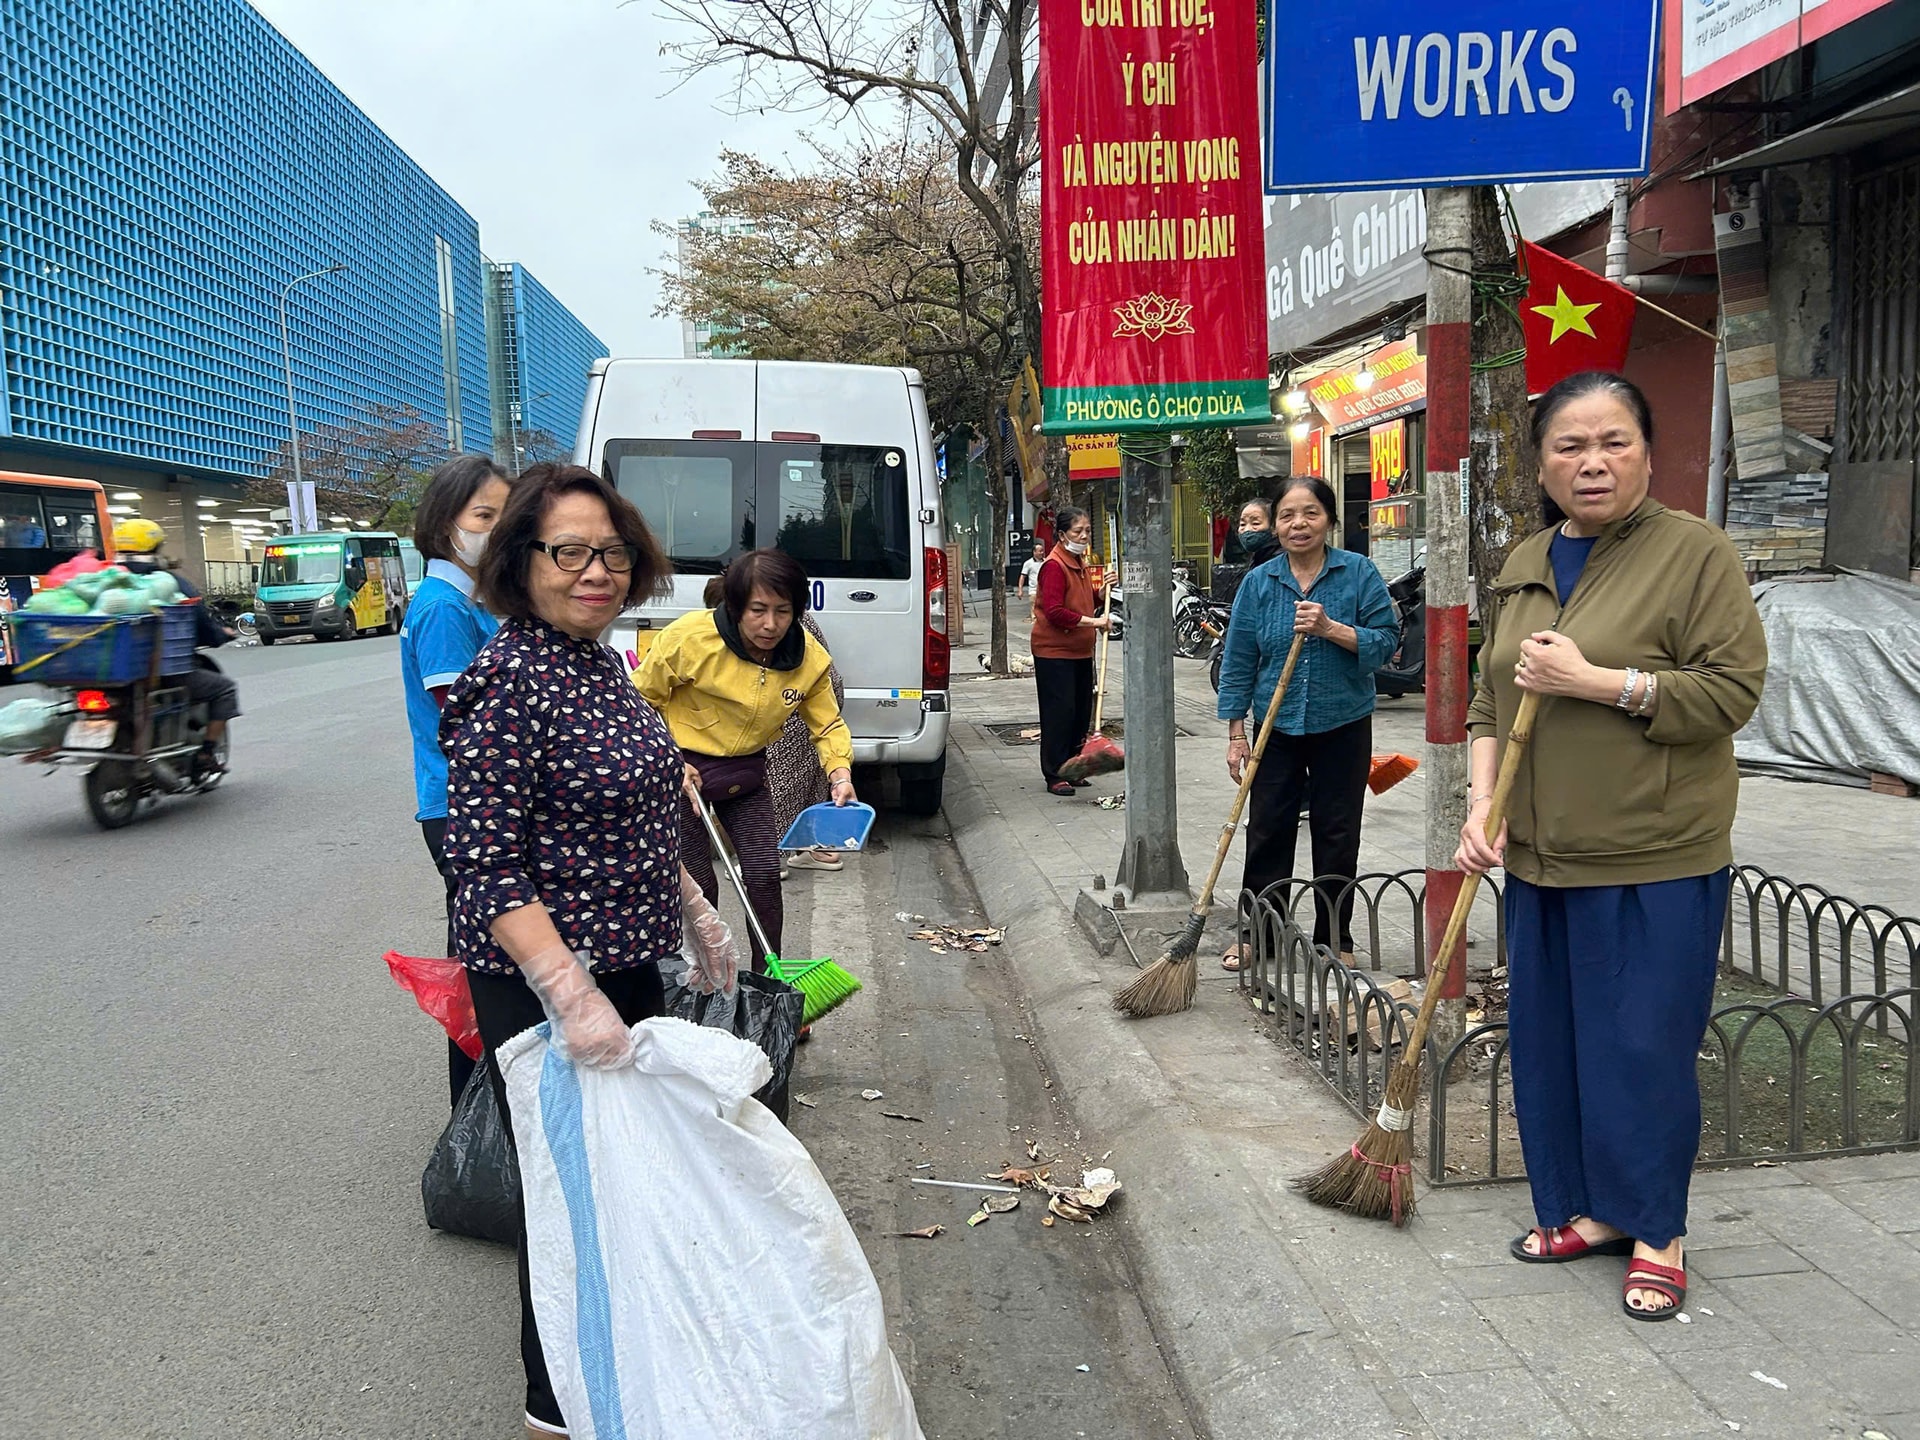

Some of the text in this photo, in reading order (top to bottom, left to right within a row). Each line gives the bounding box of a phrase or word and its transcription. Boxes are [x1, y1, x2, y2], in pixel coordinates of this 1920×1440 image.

[1122, 53, 1176, 106] Ý CHÍ
[1354, 27, 1577, 120] WORKS
[1063, 131, 1240, 194] VÀ NGUYỆN VỌNG
[1069, 206, 1112, 265] CỦA
[1118, 209, 1177, 263] NHÂN
[1183, 208, 1236, 260] DÂN!
[1267, 257, 1295, 321] Gà
[1300, 226, 1345, 309] Quê
[1066, 390, 1246, 421] PHƯỜNG Ô CHỢ DỪA
[1372, 388, 1403, 408] CHÍNH
[1010, 532, 1020, 546] P
